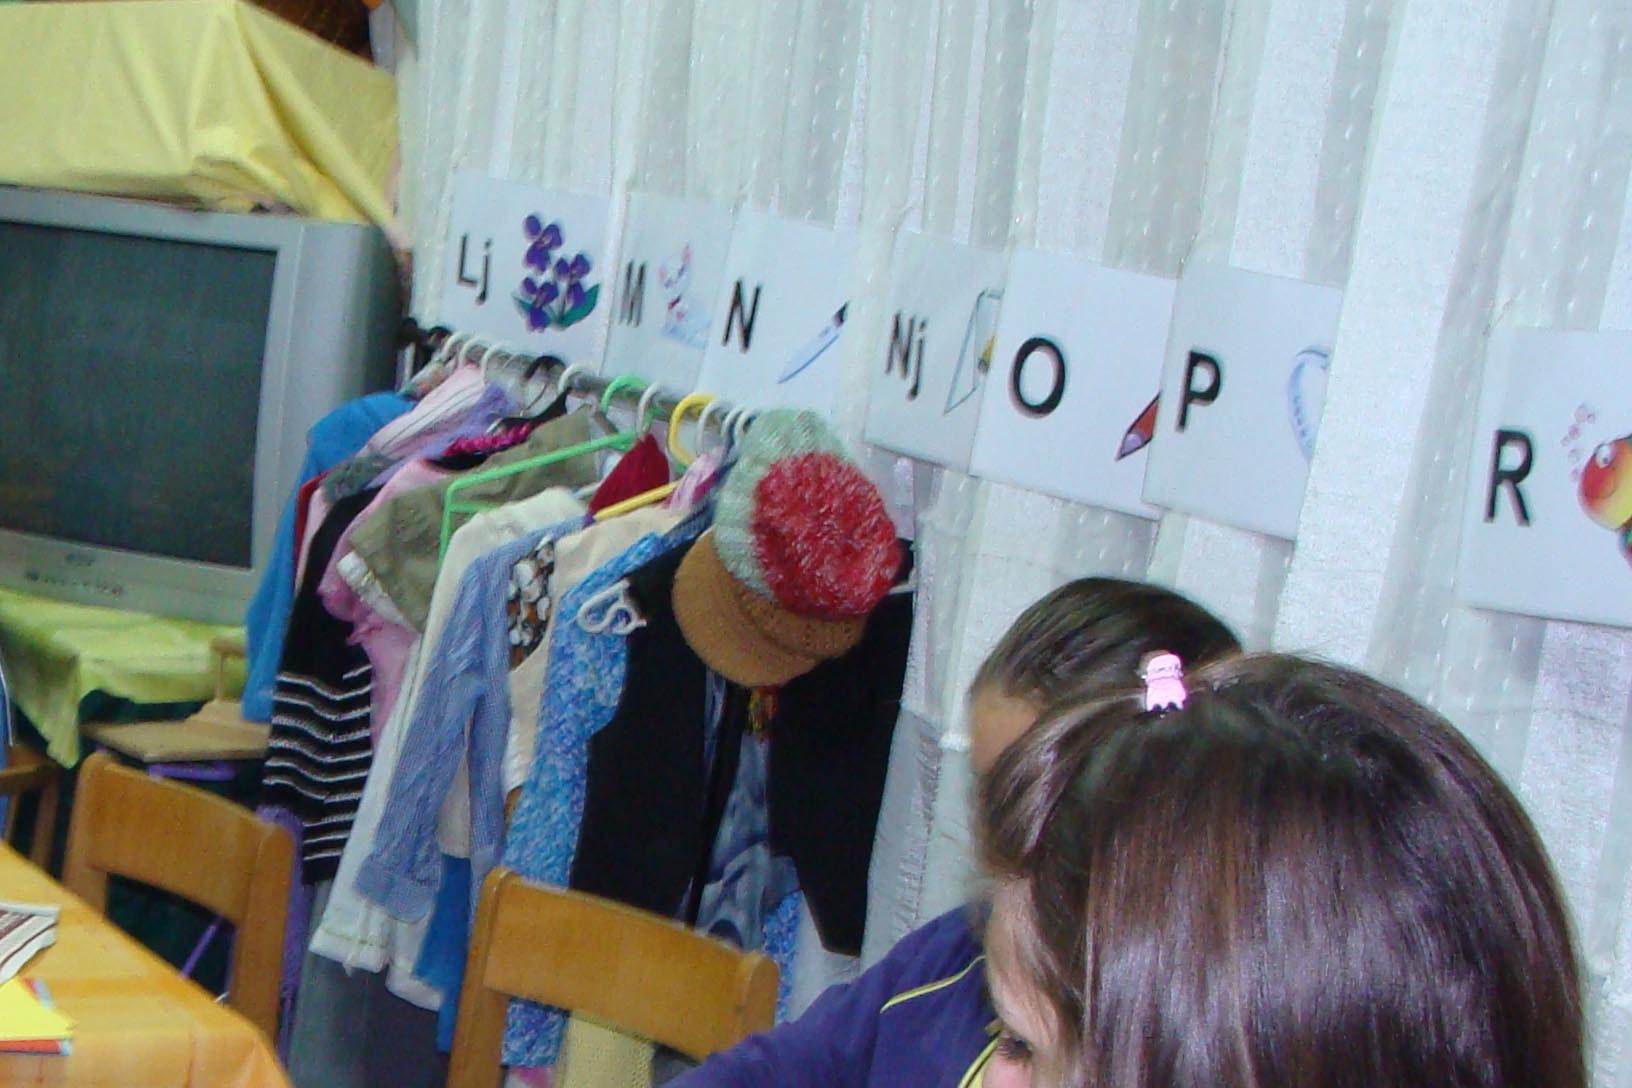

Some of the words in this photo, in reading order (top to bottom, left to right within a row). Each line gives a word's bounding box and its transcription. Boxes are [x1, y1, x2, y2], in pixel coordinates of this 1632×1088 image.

[457, 232, 493, 304] Lj
[620, 260, 648, 328] M
[721, 278, 761, 353] N
[885, 312, 928, 400] Nj
[1008, 336, 1067, 419] O
[1175, 350, 1221, 434] P
[1483, 428, 1533, 527] R
